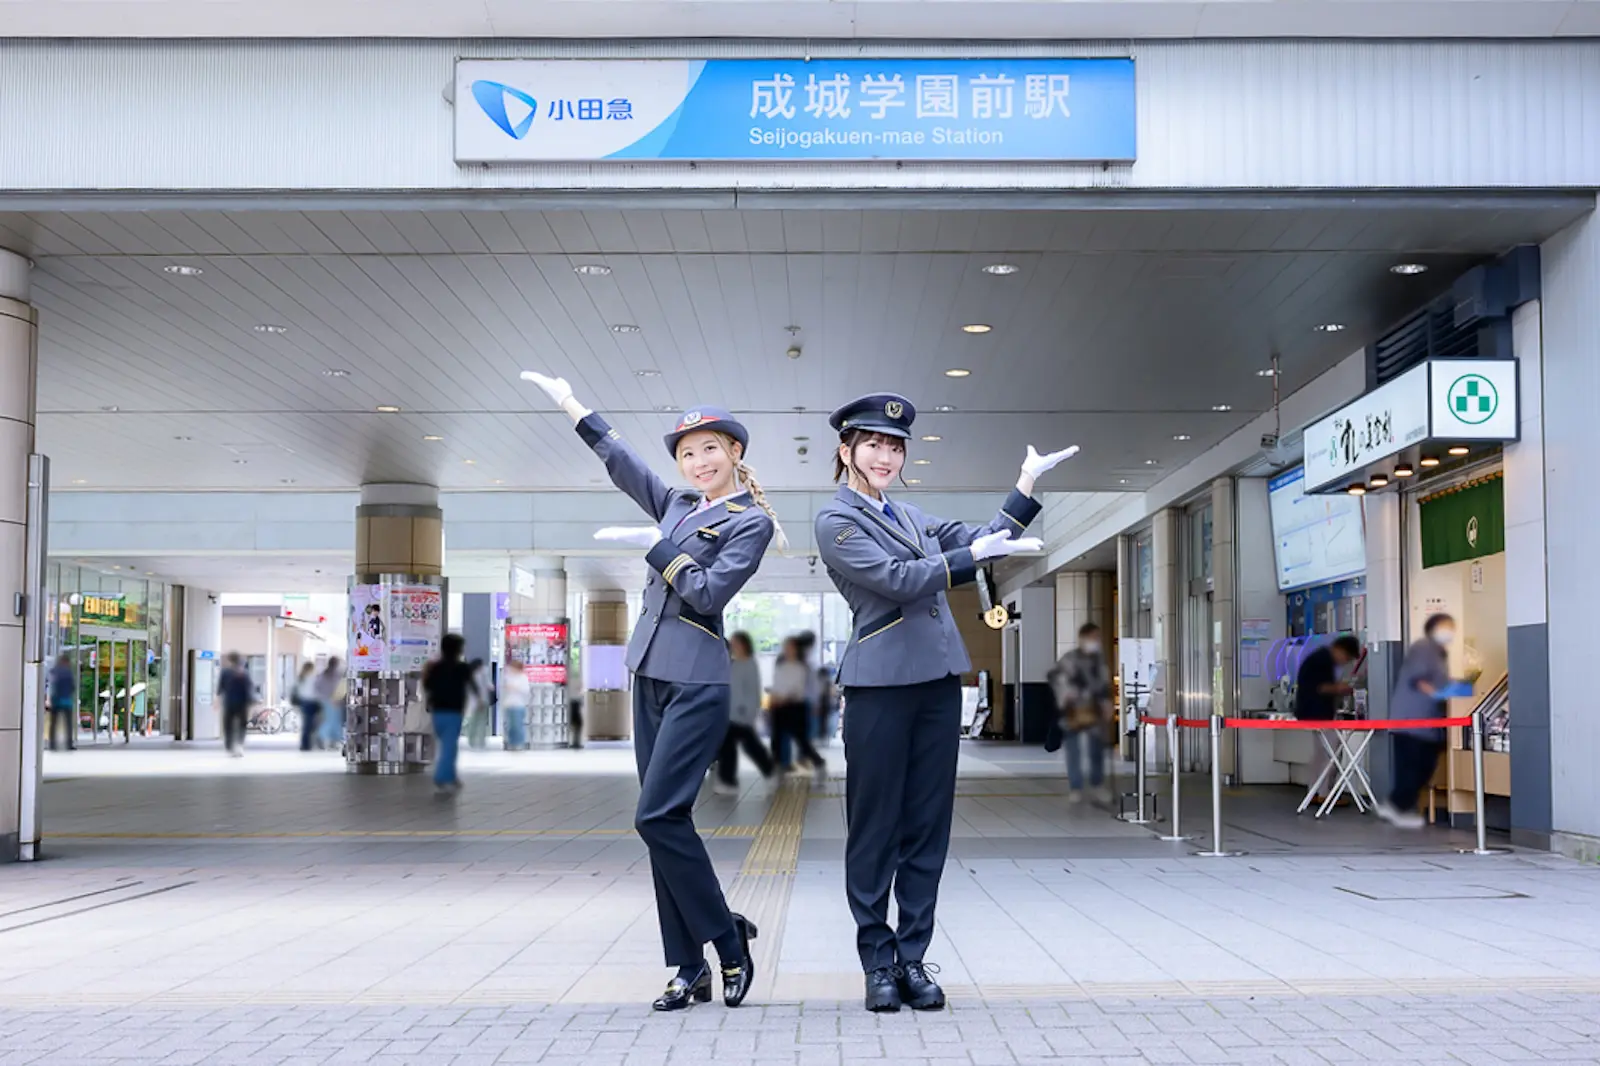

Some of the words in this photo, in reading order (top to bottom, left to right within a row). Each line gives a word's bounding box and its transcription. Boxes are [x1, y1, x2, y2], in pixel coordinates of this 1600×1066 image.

[749, 73, 1072, 120] 成城学園前駅
[547, 98, 634, 121] 小田急
[748, 126, 926, 150] Seijogakuen-mae
[931, 126, 1004, 146] Station
